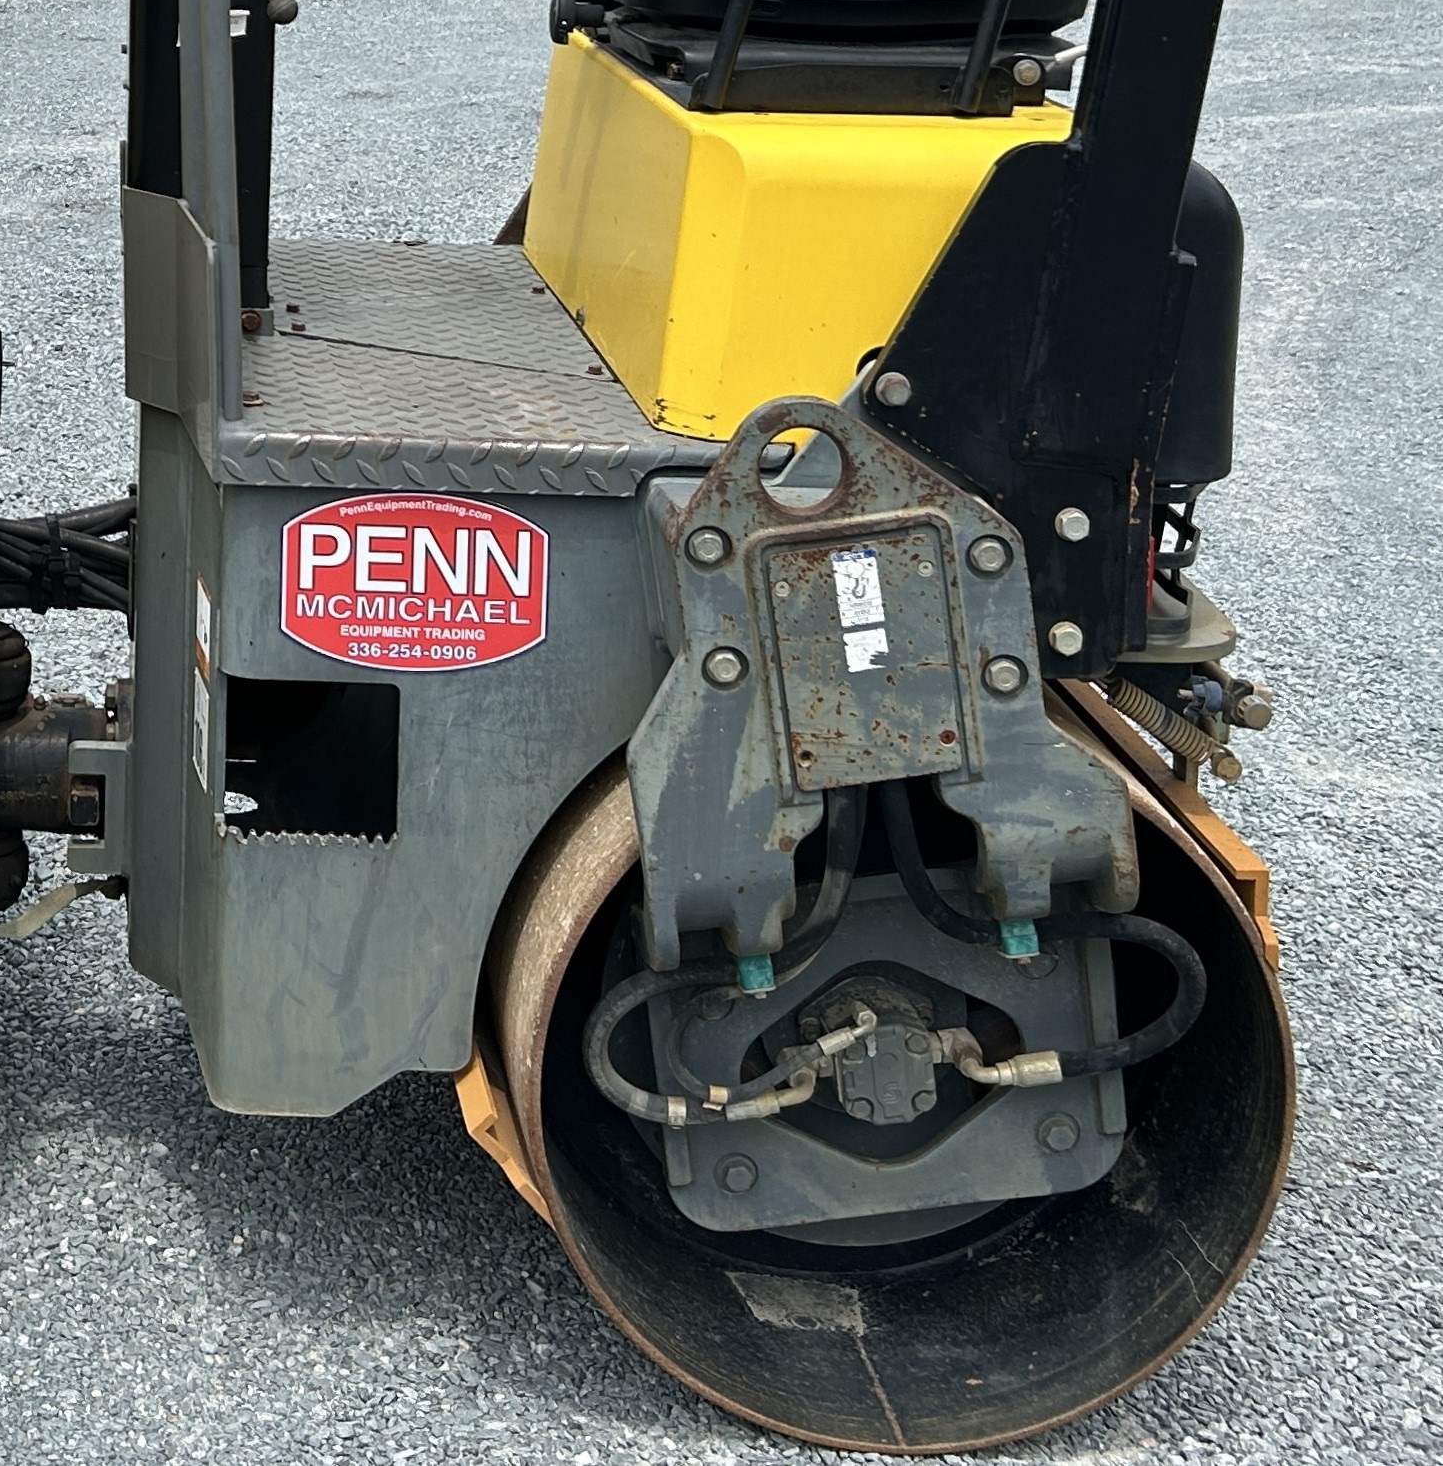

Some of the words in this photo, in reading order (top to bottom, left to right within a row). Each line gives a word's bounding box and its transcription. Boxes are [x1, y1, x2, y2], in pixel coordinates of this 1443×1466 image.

[338, 499, 493, 522] PennEquipmentTrading.com
[298, 522, 532, 597] PENN
[295, 593, 532, 625] MCMICHAEL
[339, 624, 420, 639] EQUIPMENT
[423, 627, 486, 641] TRADING
[347, 641, 477, 661] 336-254-0906
